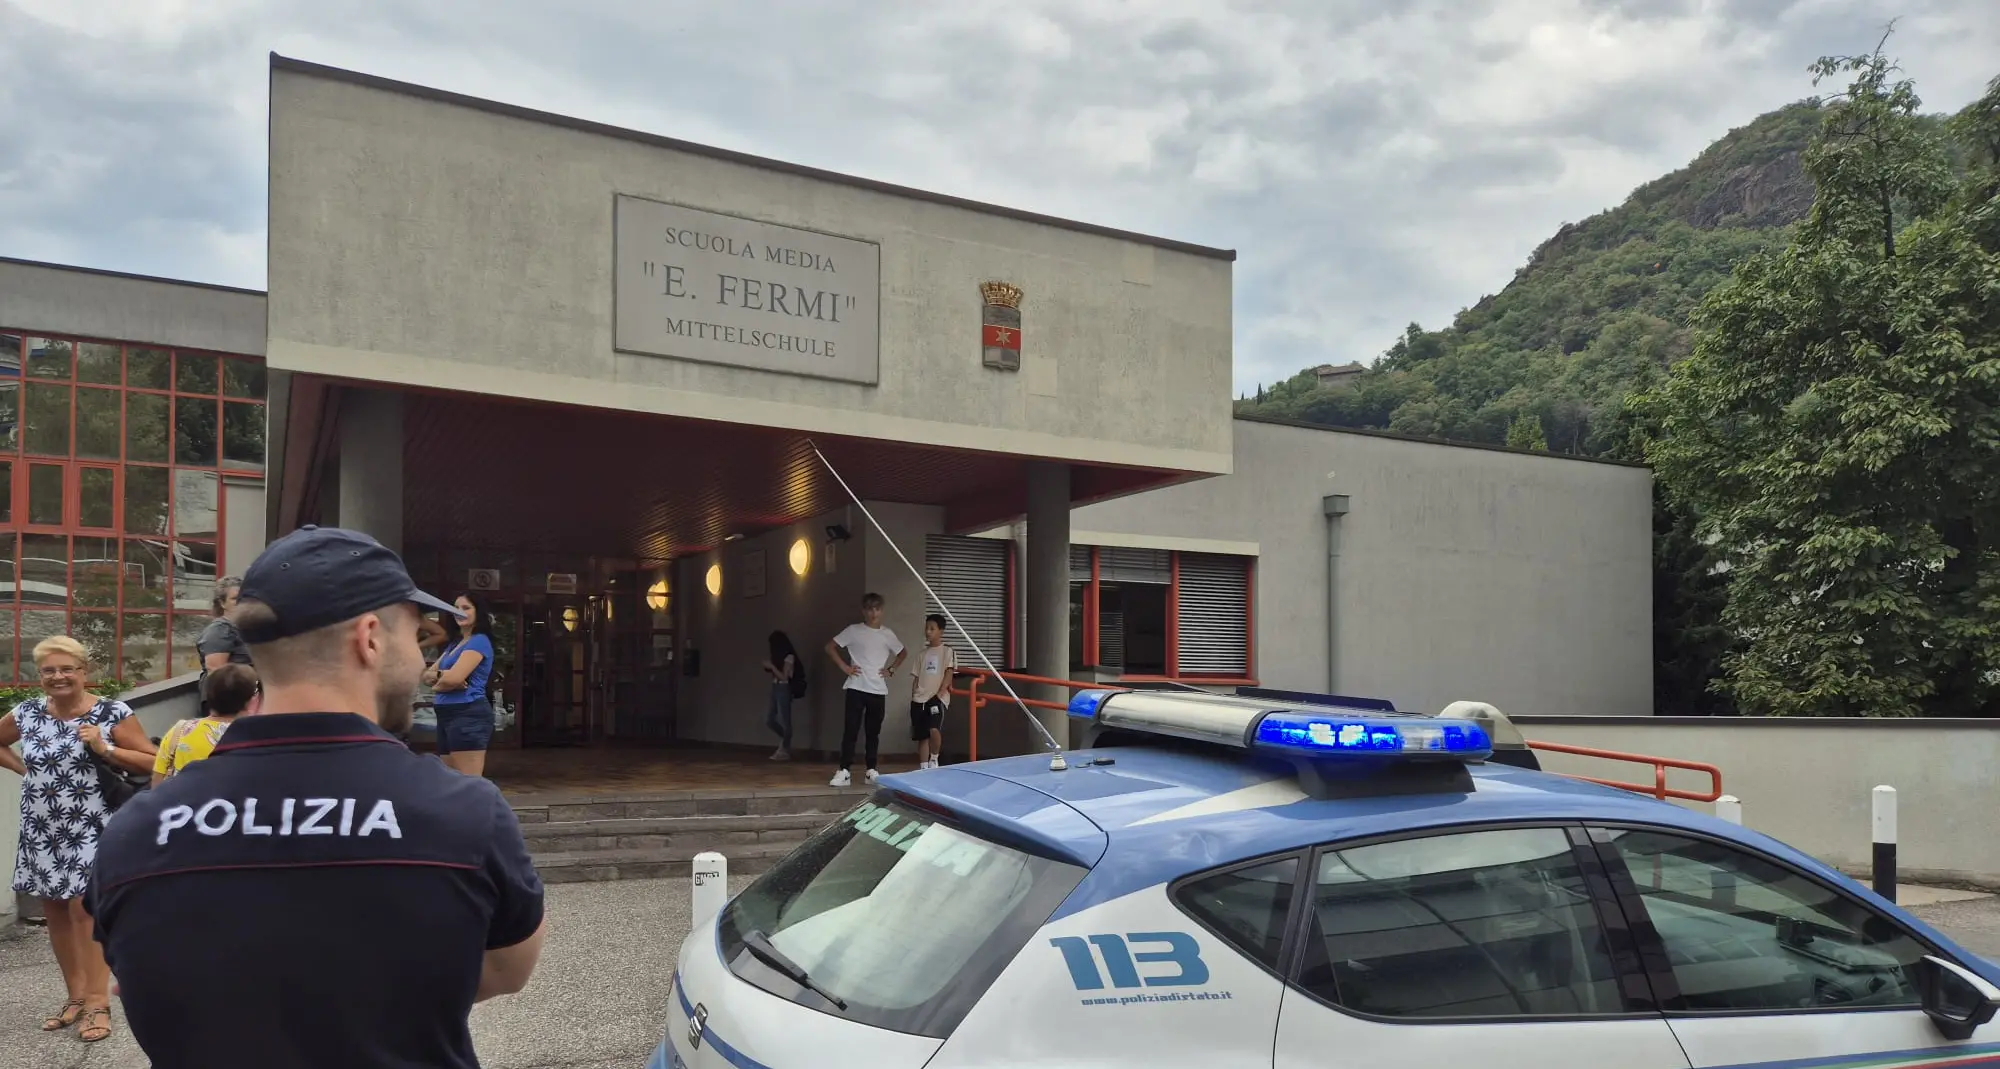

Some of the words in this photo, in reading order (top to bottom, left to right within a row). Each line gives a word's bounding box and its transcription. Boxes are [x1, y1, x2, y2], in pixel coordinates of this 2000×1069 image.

[665, 227, 755, 259] SCUOLA
[765, 245, 836, 273] MEDIA
[716, 273, 856, 323] FERMI"
[666, 317, 836, 358] MITTELSCHULE
[156, 797, 403, 845] POLIZIA
[843, 802, 987, 876] POLIZA
[1049, 931, 1210, 990] 113
[1081, 991, 1232, 1006] www.poliziadistato.it
